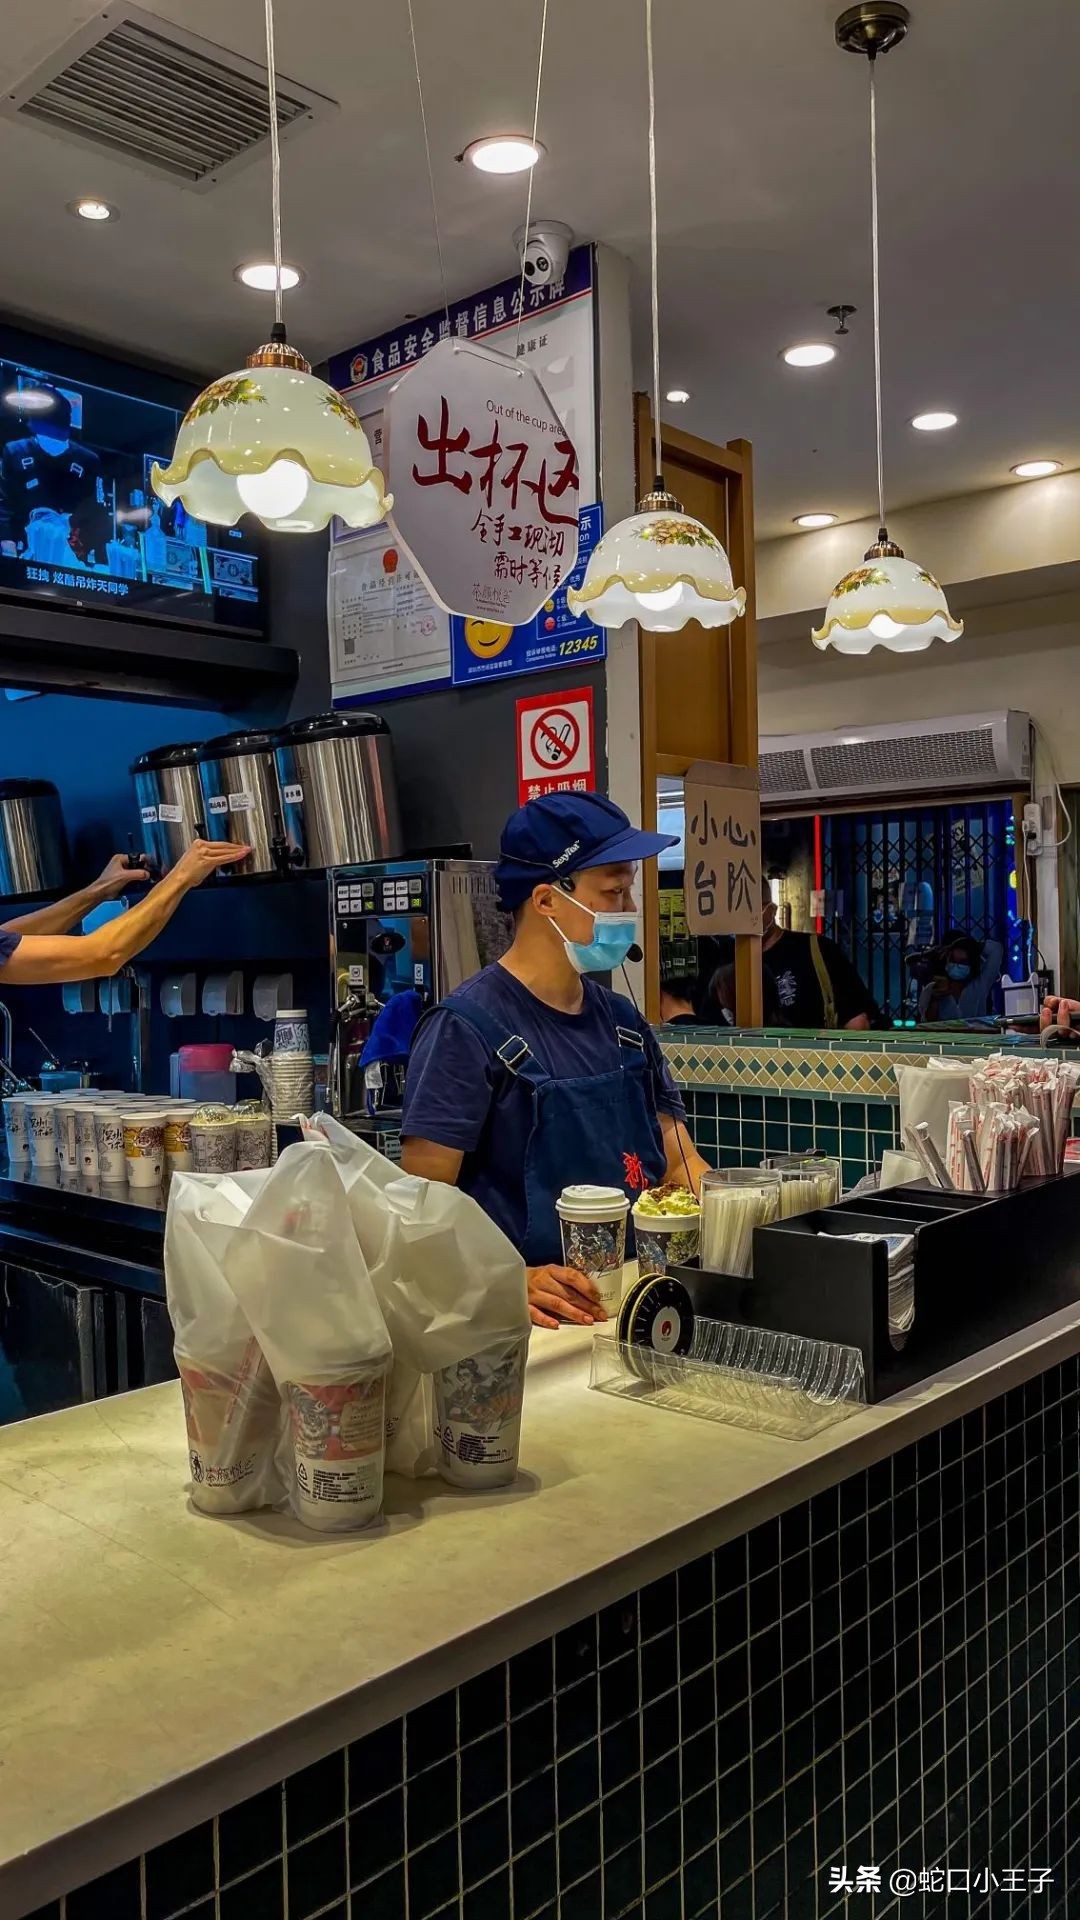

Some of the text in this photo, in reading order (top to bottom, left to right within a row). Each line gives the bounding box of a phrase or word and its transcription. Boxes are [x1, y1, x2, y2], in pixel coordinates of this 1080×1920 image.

[371, 281, 565, 375] 食品安全监督信息公示牌
[516, 333, 548, 357] 健康证
[486, 399, 503, 416] Out
[505, 407, 515, 418] of
[516, 409, 530, 424] the
[531, 418, 548, 432] cup
[412, 395, 579, 528] 出杯区
[494, 551, 561, 590] 需时等候
[559, 635, 599, 656] 12345
[690, 800, 757, 847] 小心
[694, 859, 757, 916] 台阶
